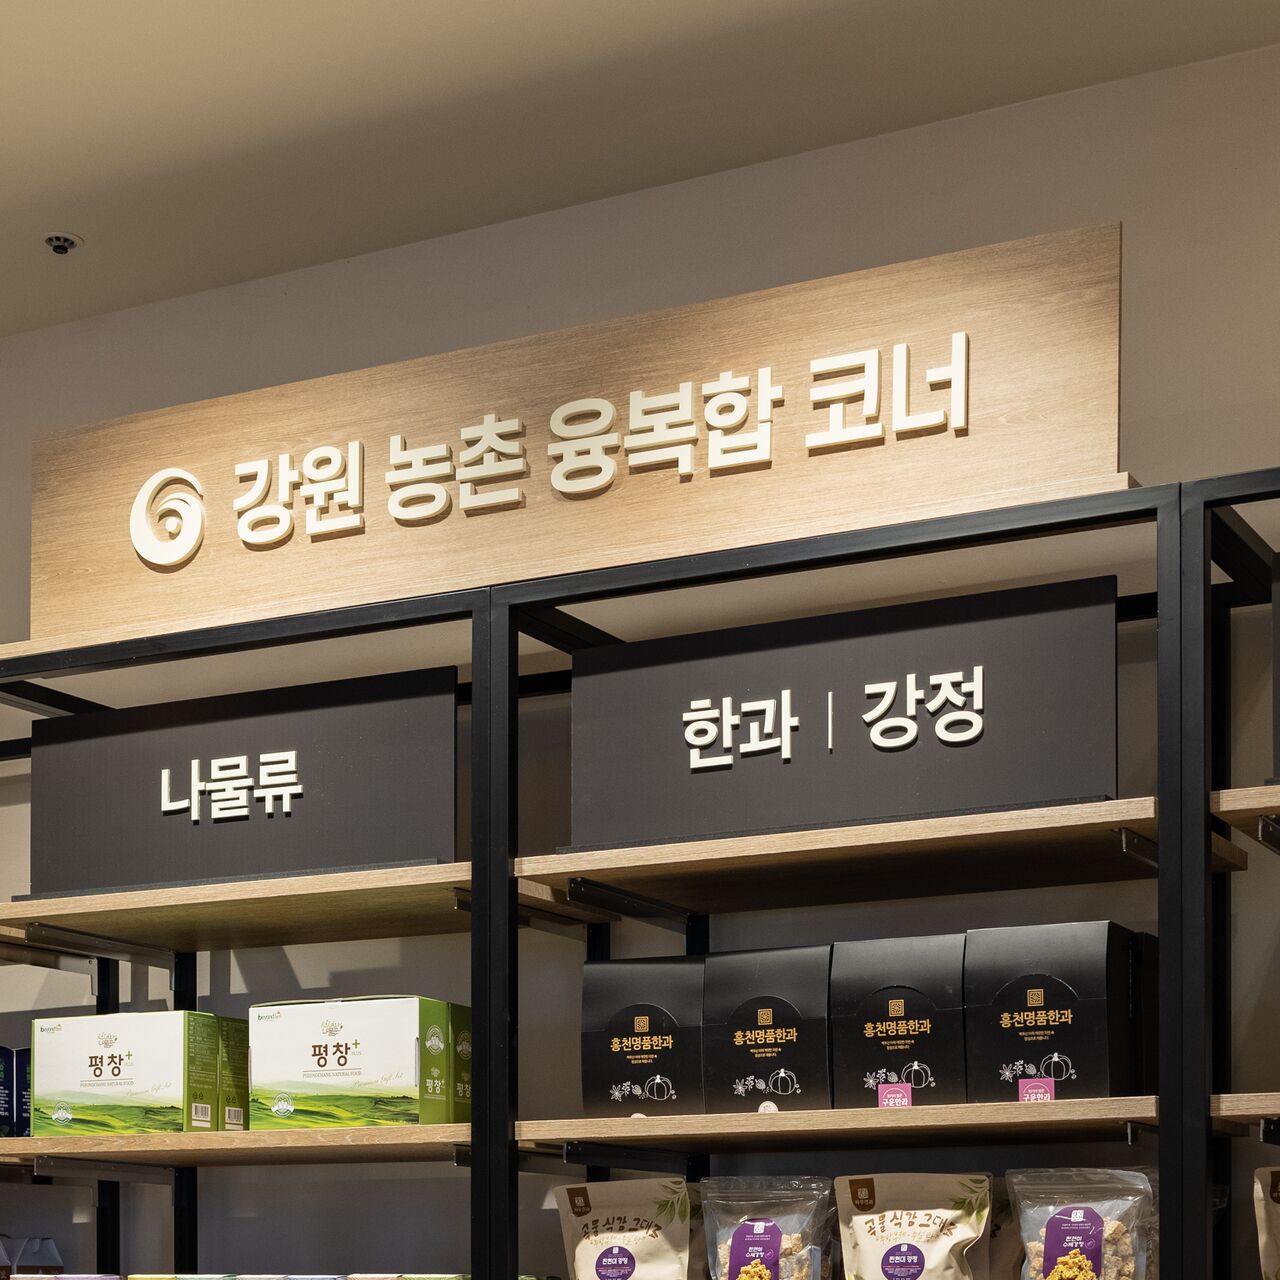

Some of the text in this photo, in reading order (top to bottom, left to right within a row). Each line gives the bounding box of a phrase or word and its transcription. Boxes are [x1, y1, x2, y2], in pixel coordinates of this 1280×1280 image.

[232, 331, 970, 547] 강원 농촌 융복합 코너
[682, 665, 984, 771] 한과 강정
[161, 750, 303, 822] 나물류
[863, 1019, 931, 1038] 홍천명품한과
[1000, 1009, 1073, 1028] 홍천명품한과
[610, 1035, 673, 1052] 홍천명품한과
[733, 1028, 798, 1045] 홍천명품한과
[88, 1054, 124, 1077] 평창
[311, 1042, 350, 1067] 평창
[602, 1215, 628, 1233] 식감
[632, 1217, 662, 1239] 그대로
[864, 1210, 958, 1237] 곡물 식감 그대로
